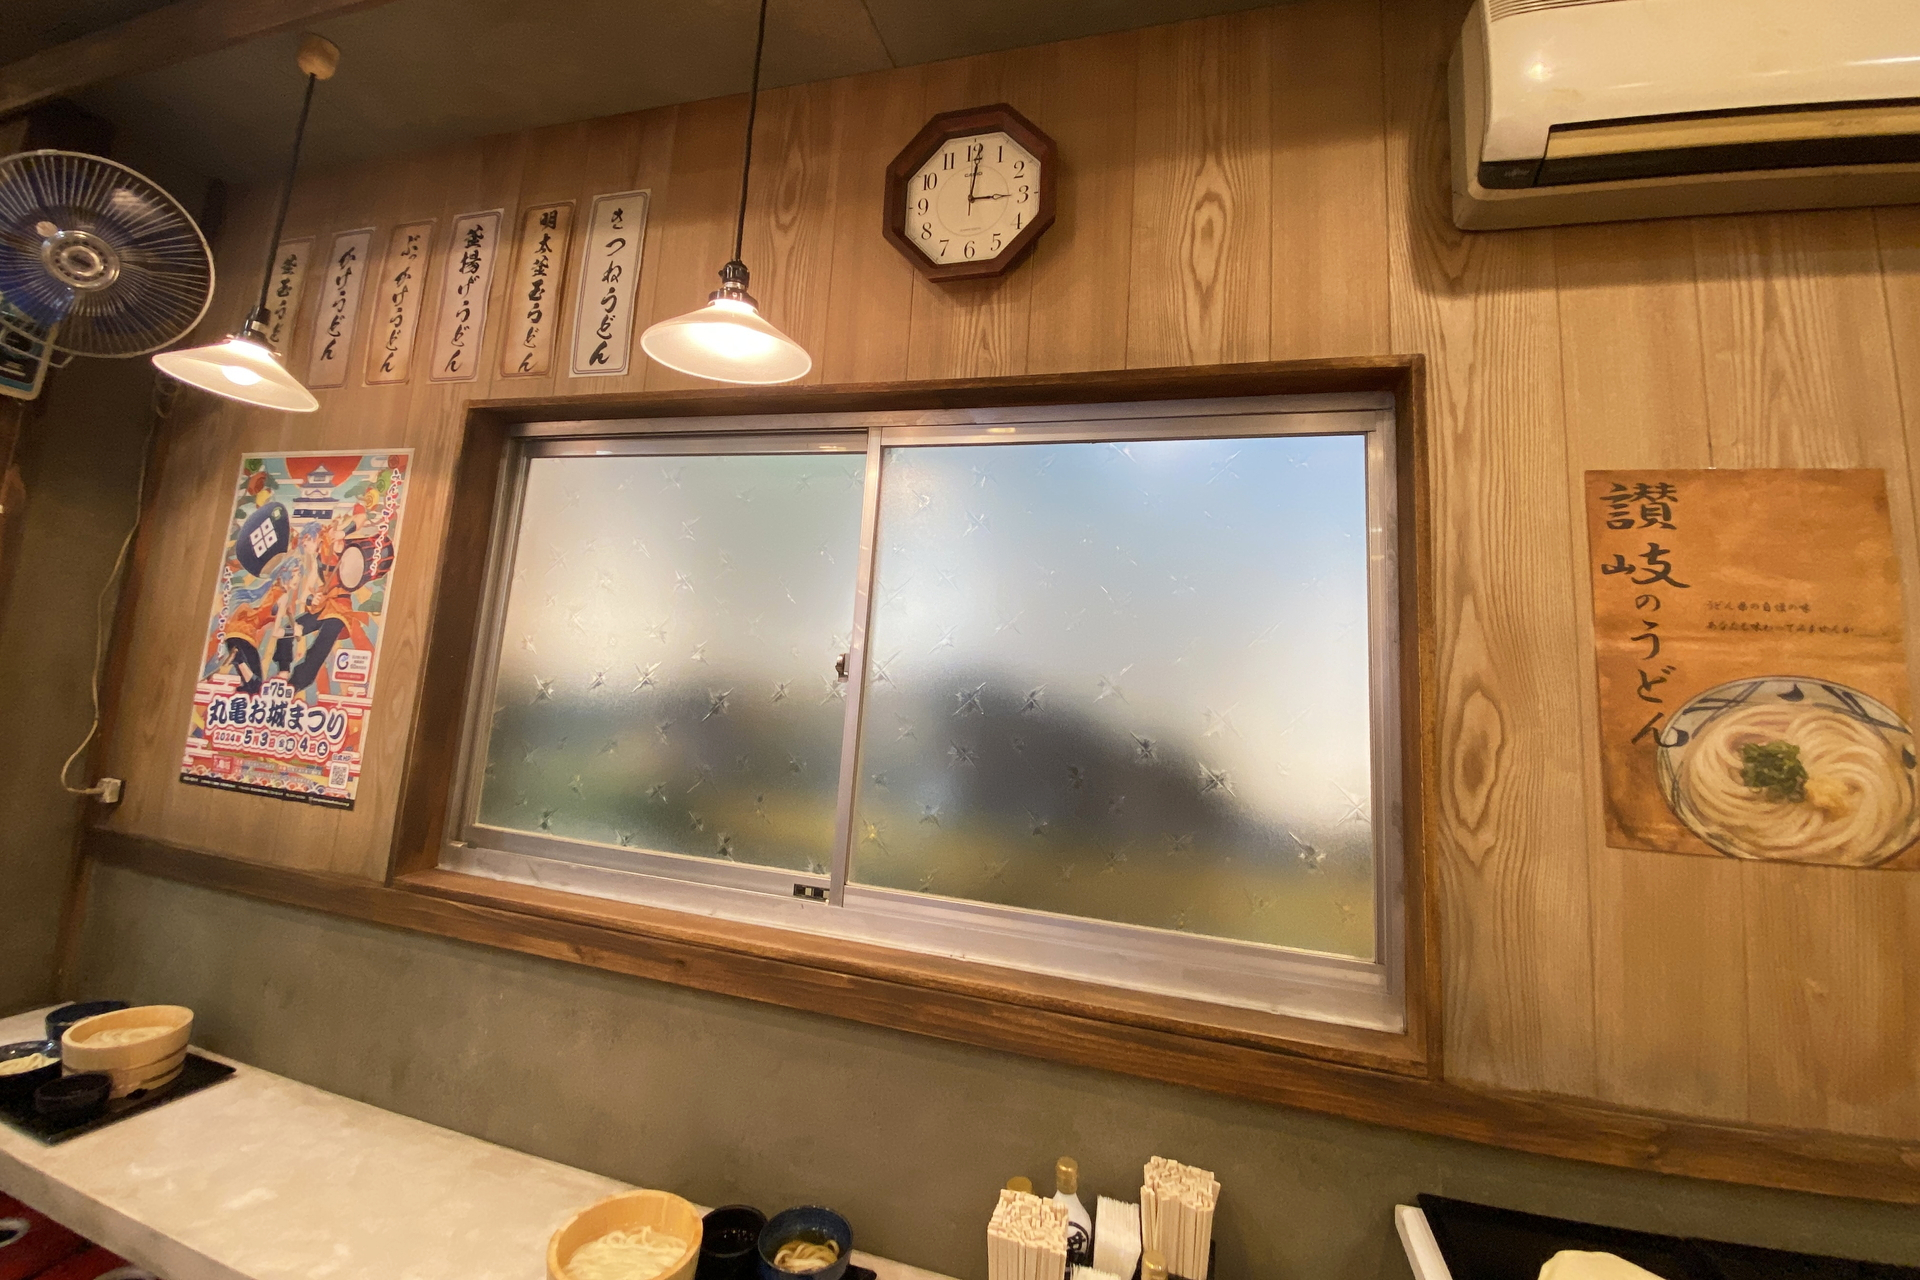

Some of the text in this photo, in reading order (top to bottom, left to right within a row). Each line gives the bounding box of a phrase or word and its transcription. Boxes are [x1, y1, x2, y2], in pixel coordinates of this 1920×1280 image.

[943, 152, 955, 170] 11
[966, 143, 984, 163] 12
[998, 146, 1004, 163] 1
[1013, 160, 1026, 179] 2
[922, 172, 938, 191] 10
[1016, 185, 1029, 204] 3
[917, 198, 929, 216] 9
[1010, 212, 1023, 230] 4
[921, 222, 932, 241] 8
[939, 239, 950, 257] 7
[963, 241, 975, 259] 6
[990, 233, 1002, 251] 5
[517, 209, 559, 374] 明太釜玉うどん
[588, 207, 628, 367] きつねうどん
[270, 253, 298, 343] 釜玉うど
[319, 246, 357, 362] かけうどん
[380, 234, 422, 374] ぶっかけうどん
[444, 223, 486, 374] 釜揚げうどん
[1599, 482, 1691, 748] 讃岐のうどん
[208, 697, 345, 740] 丸亀お城まつり
